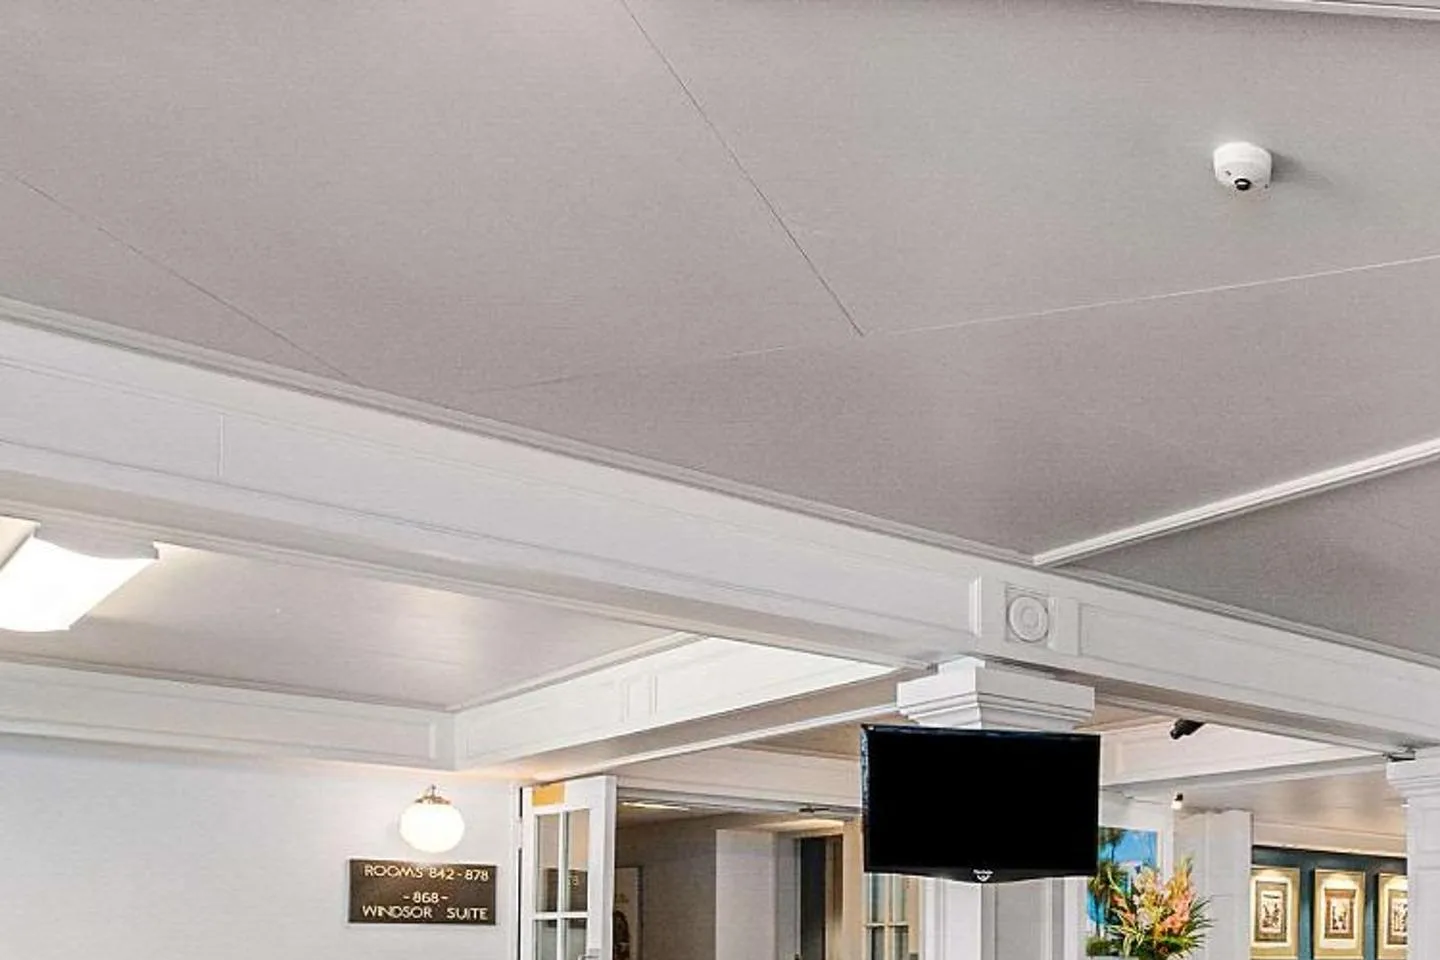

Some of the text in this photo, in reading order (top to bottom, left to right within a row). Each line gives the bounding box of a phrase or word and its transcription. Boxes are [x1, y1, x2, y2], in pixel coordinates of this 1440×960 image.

[364, 865, 423, 878] ROOMS
[362, 905, 488, 920] WINDSOR SUITE
